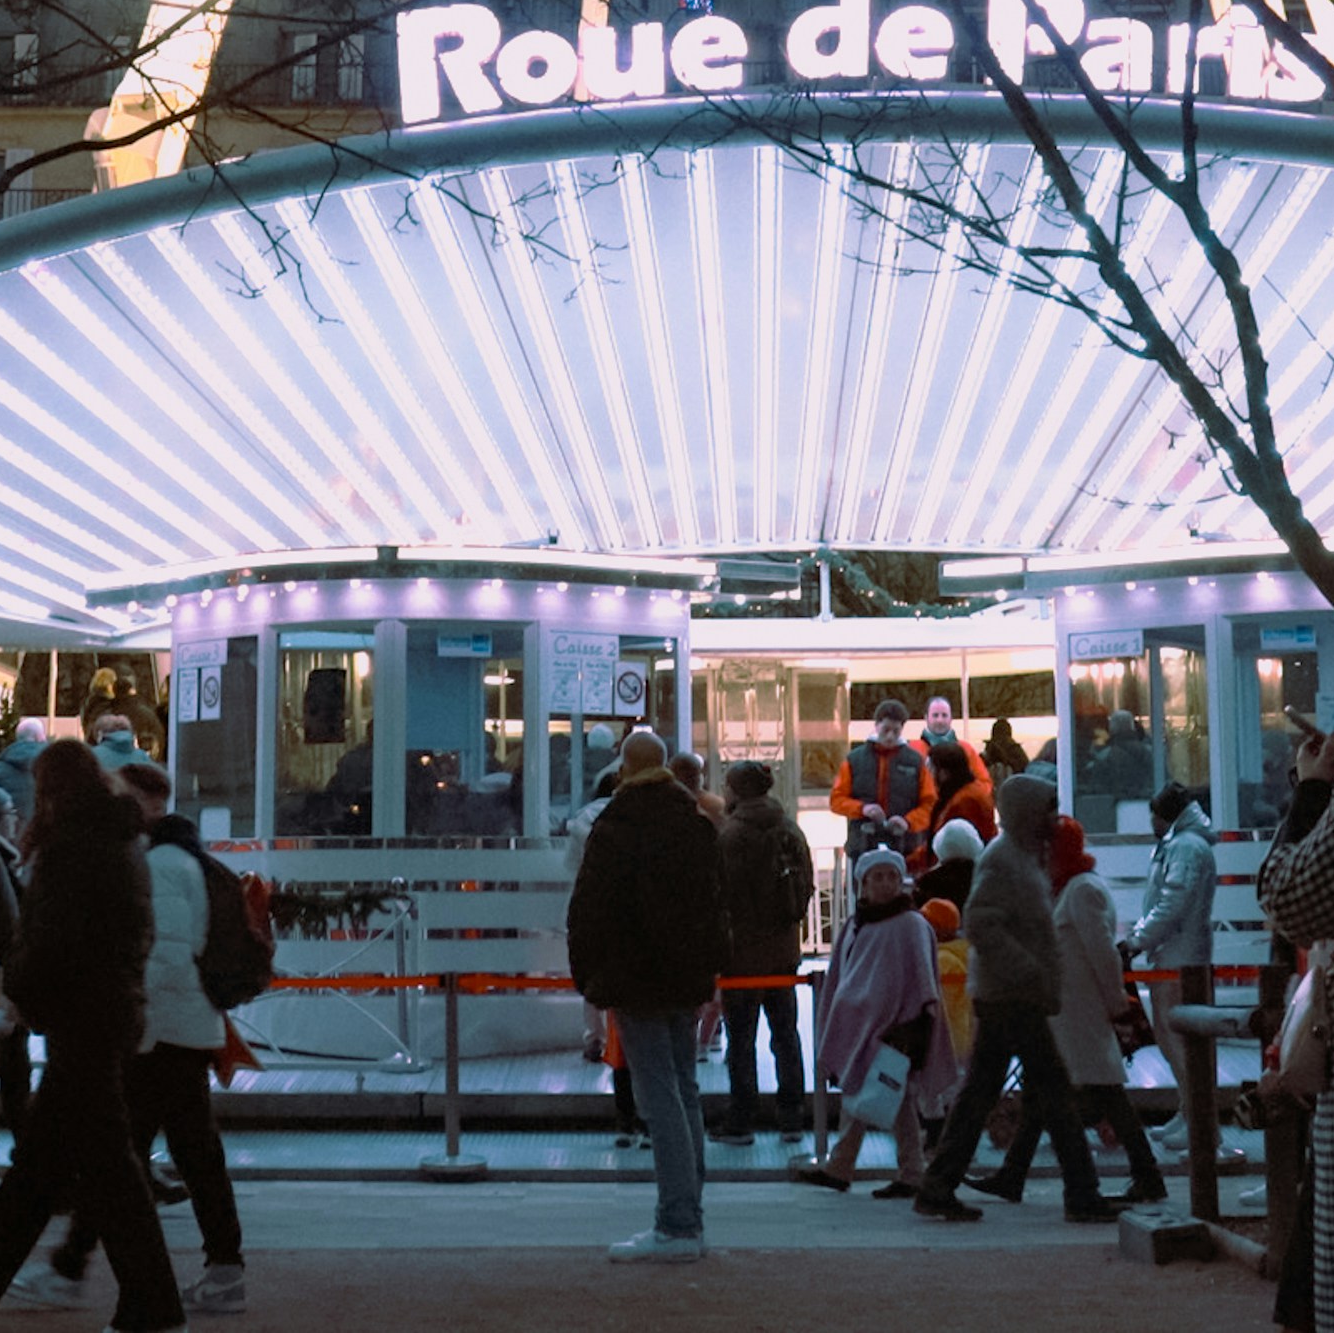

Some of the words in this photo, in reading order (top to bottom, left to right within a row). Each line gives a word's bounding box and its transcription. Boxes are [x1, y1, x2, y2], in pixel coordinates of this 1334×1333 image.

[396, 3, 748, 123] Roue
[554, 635, 603, 655] Caisse
[607, 641, 616, 657] 2
[1074, 637, 1127, 656] Caisse
[1132, 636, 1141, 653] 1
